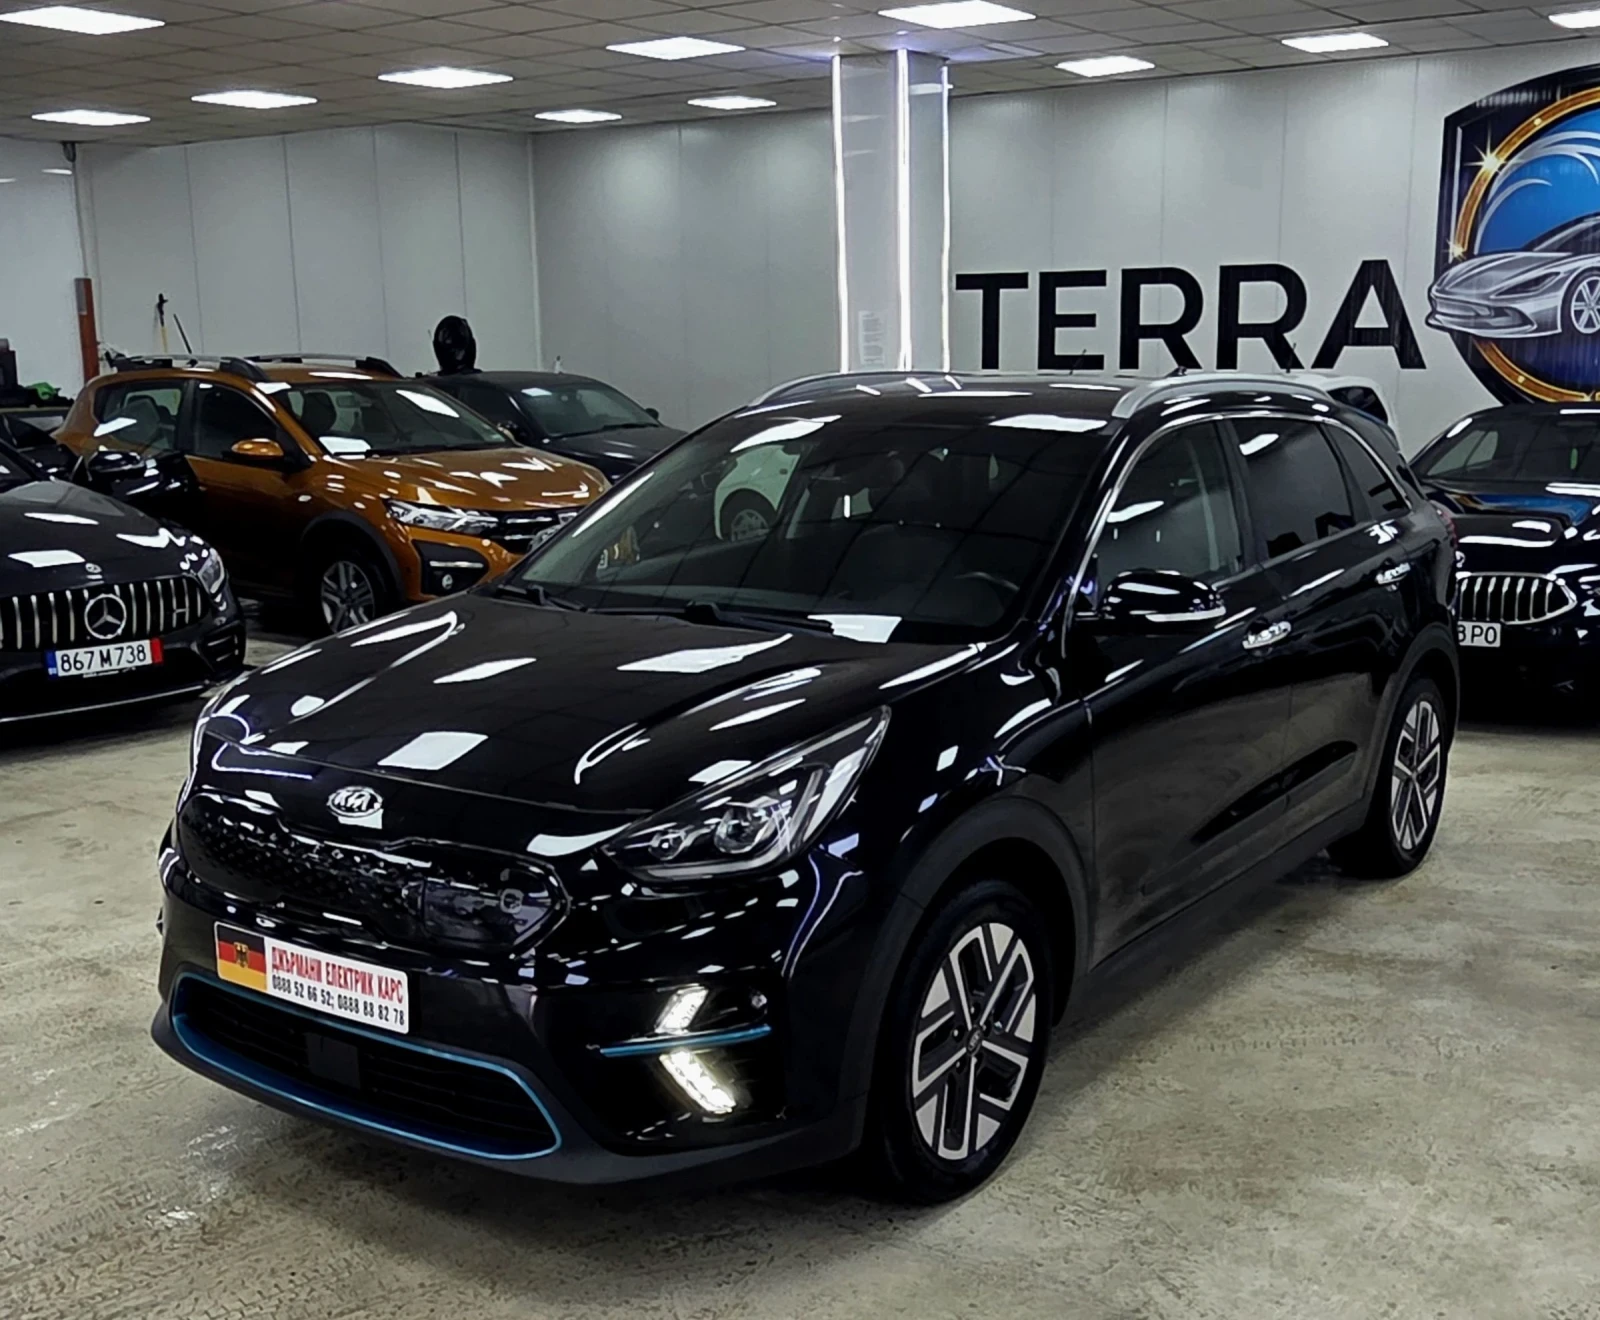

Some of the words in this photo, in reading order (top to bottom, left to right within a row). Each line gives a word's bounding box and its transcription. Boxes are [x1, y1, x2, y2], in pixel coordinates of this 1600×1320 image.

[955, 259, 1427, 370] TERRA
[272, 946, 322, 983] ДЖЪРМАНИ
[326, 962, 375, 996] ЕЛЕКТРИК
[377, 974, 403, 1004] КАРС
[294, 981, 304, 998] 52
[363, 1001, 374, 1018] 88
[378, 1004, 389, 1022] 82
[393, 1008, 405, 1026] 78
